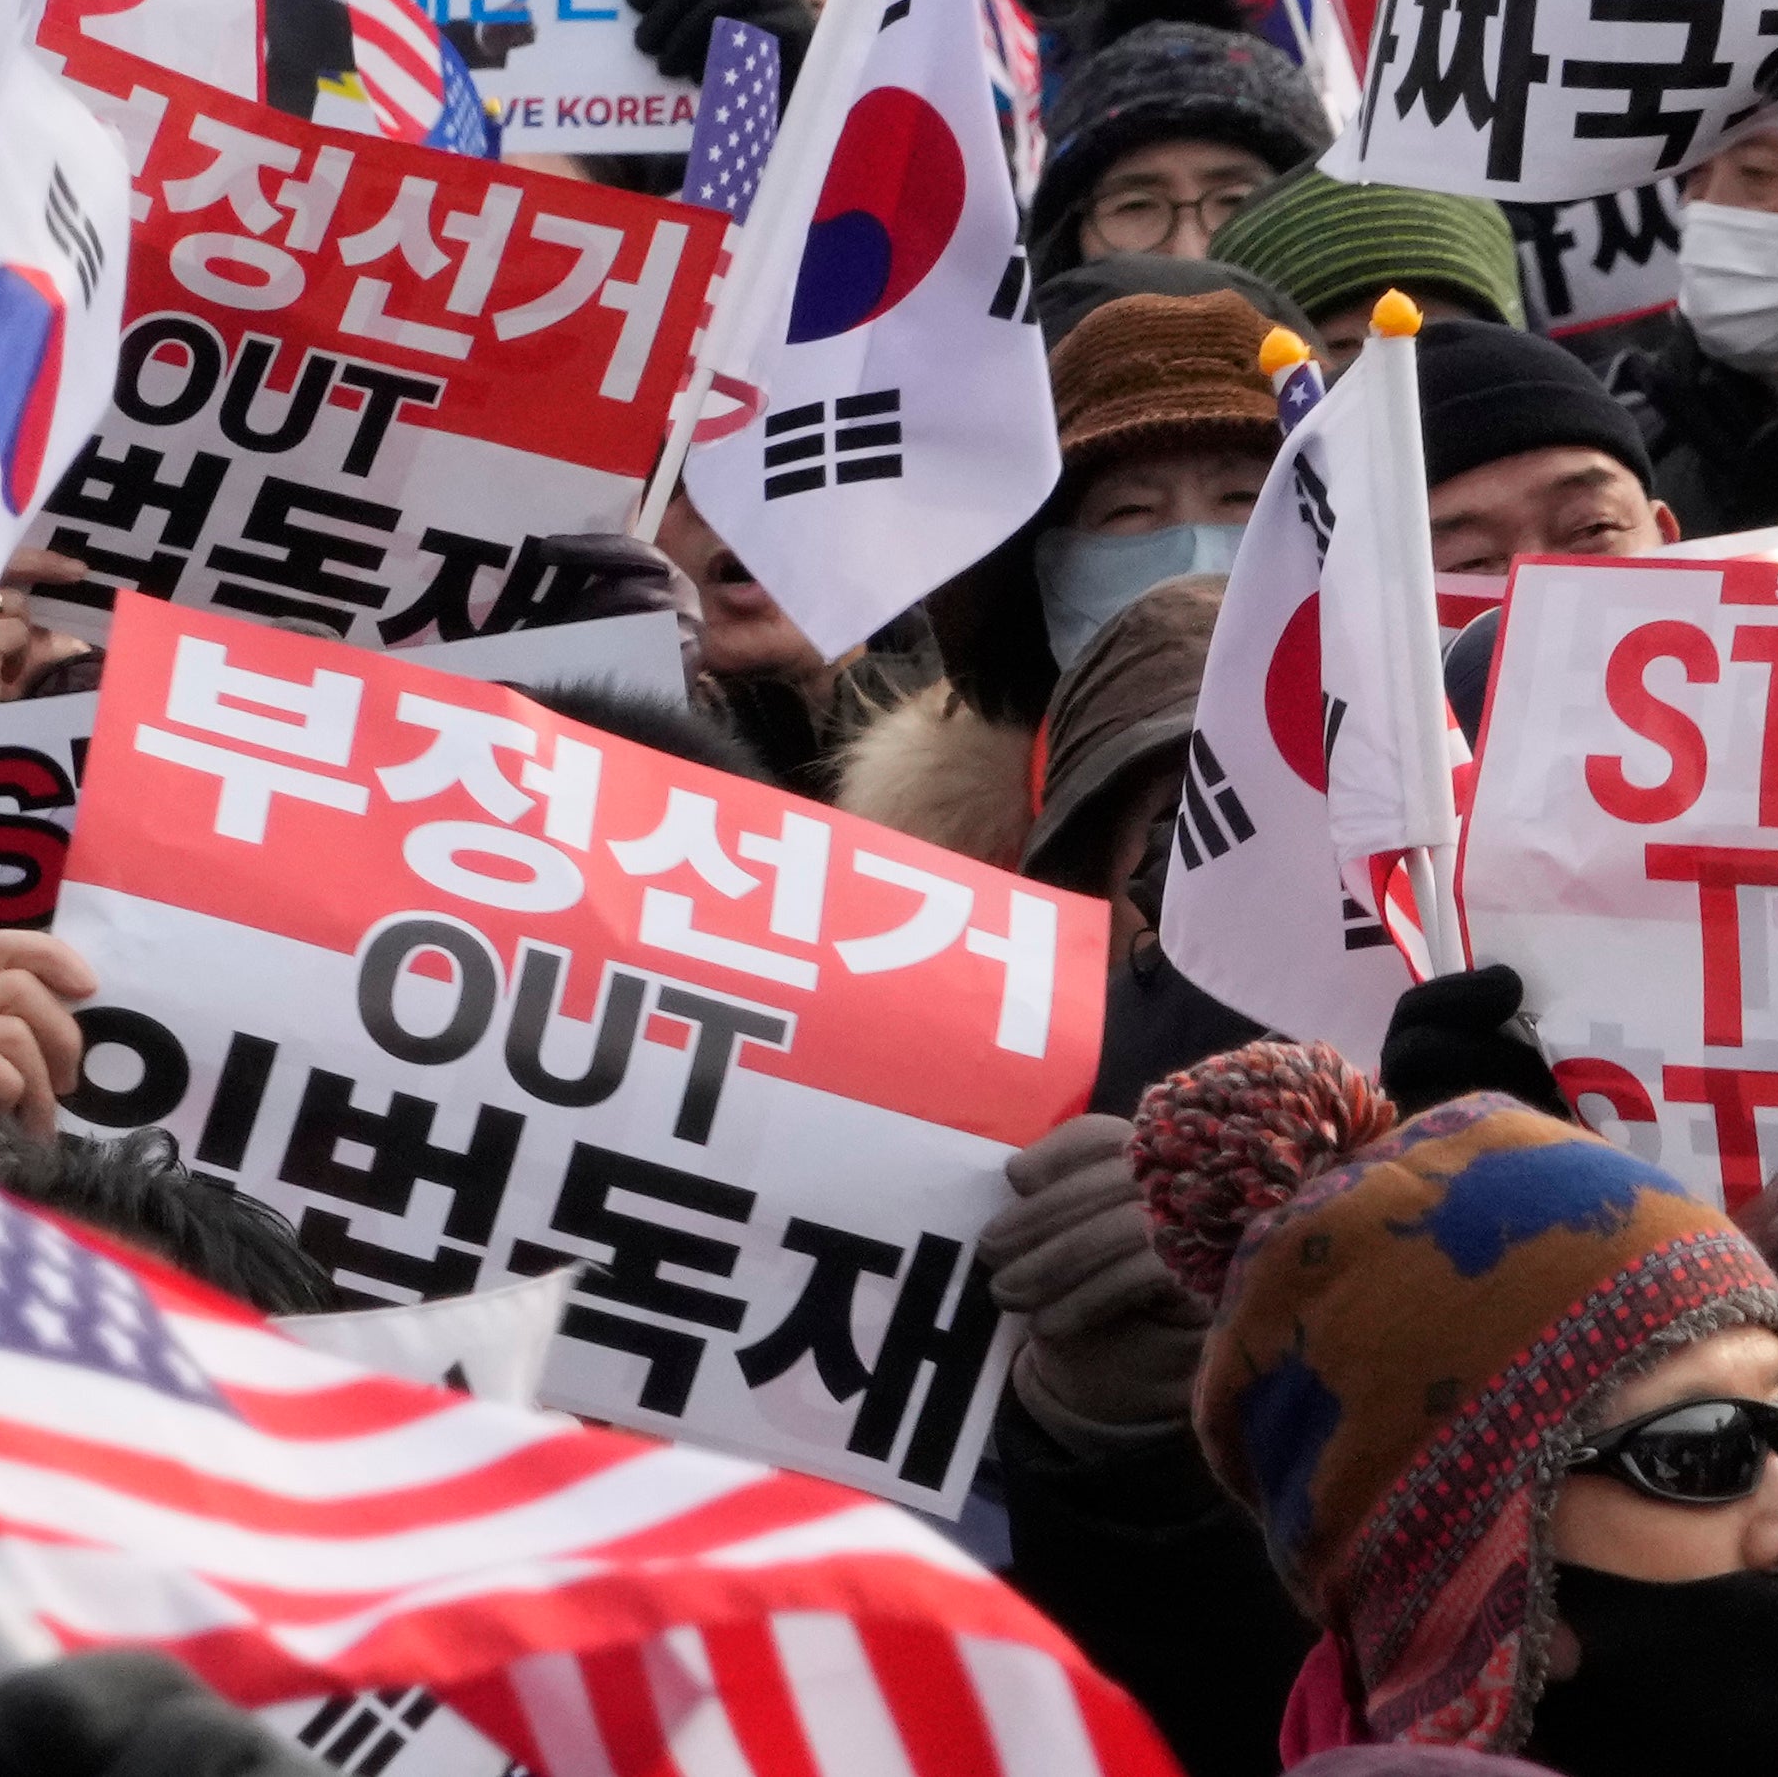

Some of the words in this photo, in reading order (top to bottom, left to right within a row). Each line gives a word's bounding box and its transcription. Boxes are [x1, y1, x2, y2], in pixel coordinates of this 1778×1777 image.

[557, 95, 695, 128] KOREA
[114, 313, 443, 478] OUT
[133, 633, 1059, 1059] 부정선거
[353, 912, 799, 1147] OUT
